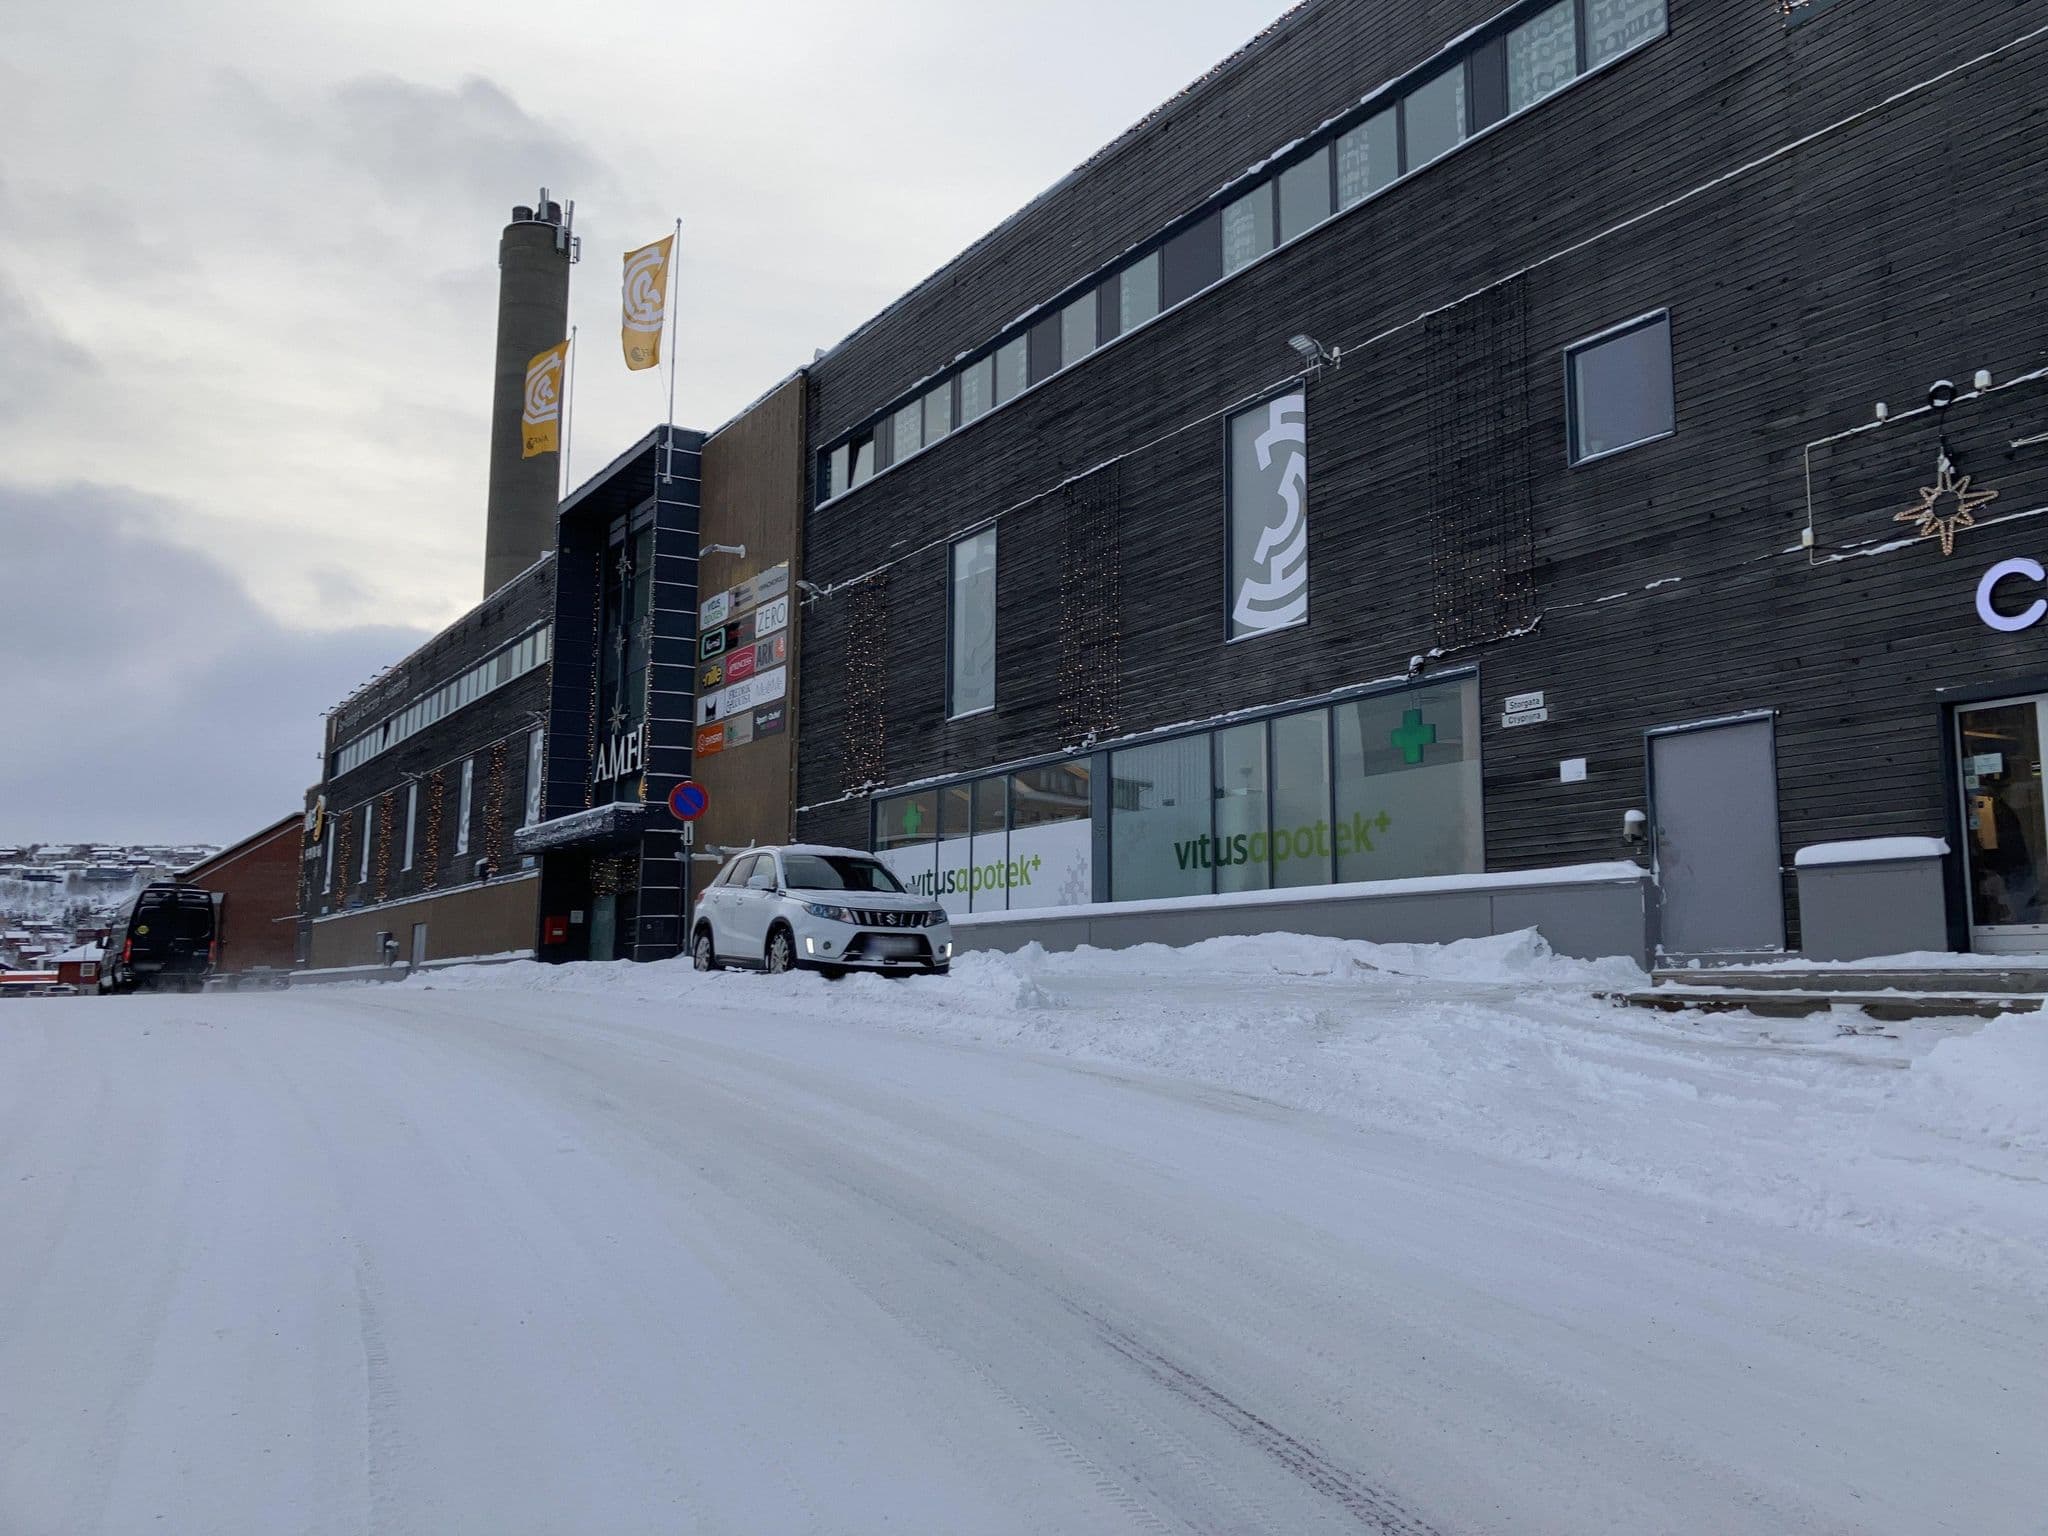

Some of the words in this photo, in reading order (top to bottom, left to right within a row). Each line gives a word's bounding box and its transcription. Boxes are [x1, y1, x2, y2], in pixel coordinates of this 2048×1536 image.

[757, 602, 786, 633] ZERO
[757, 640, 774, 668] ARK
[1509, 698, 1541, 710] Storgata
[593, 723, 644, 783] AMFI
